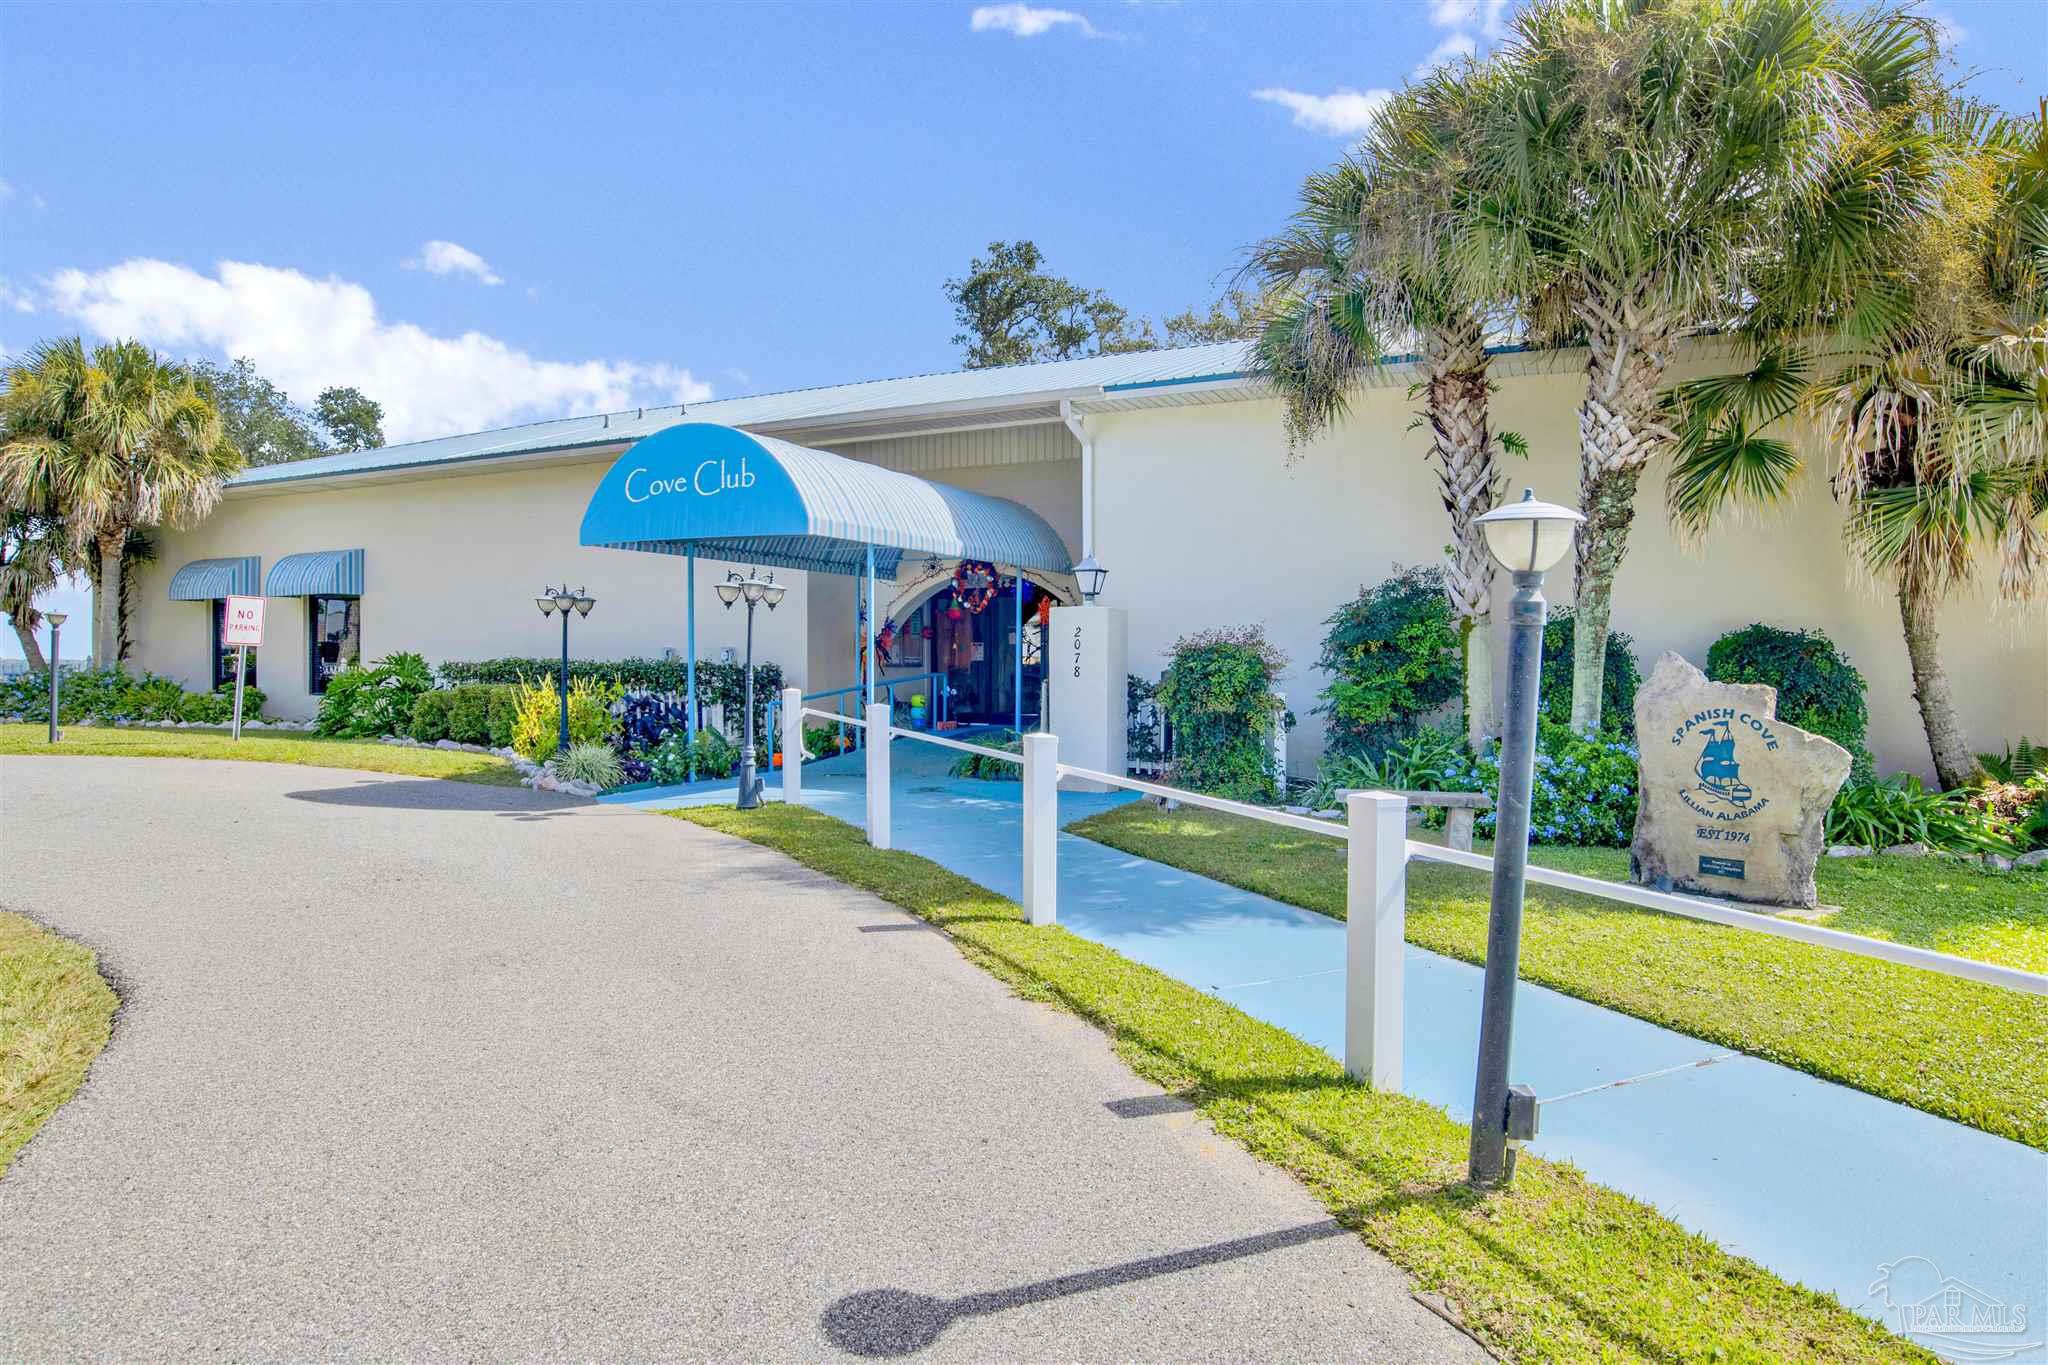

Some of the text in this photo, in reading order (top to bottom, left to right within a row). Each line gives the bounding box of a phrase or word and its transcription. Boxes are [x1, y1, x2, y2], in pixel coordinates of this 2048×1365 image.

[625, 457, 756, 503] Cove Club
[229, 624, 260, 632] PARKING
[238, 609, 254, 620] NO
[1073, 625, 1081, 678] 2078
[1672, 708, 1779, 752] SPANISH COVE
[1679, 788, 1770, 821] LILLIAN ALABAMA
[1696, 828, 1751, 843] EST 1974
